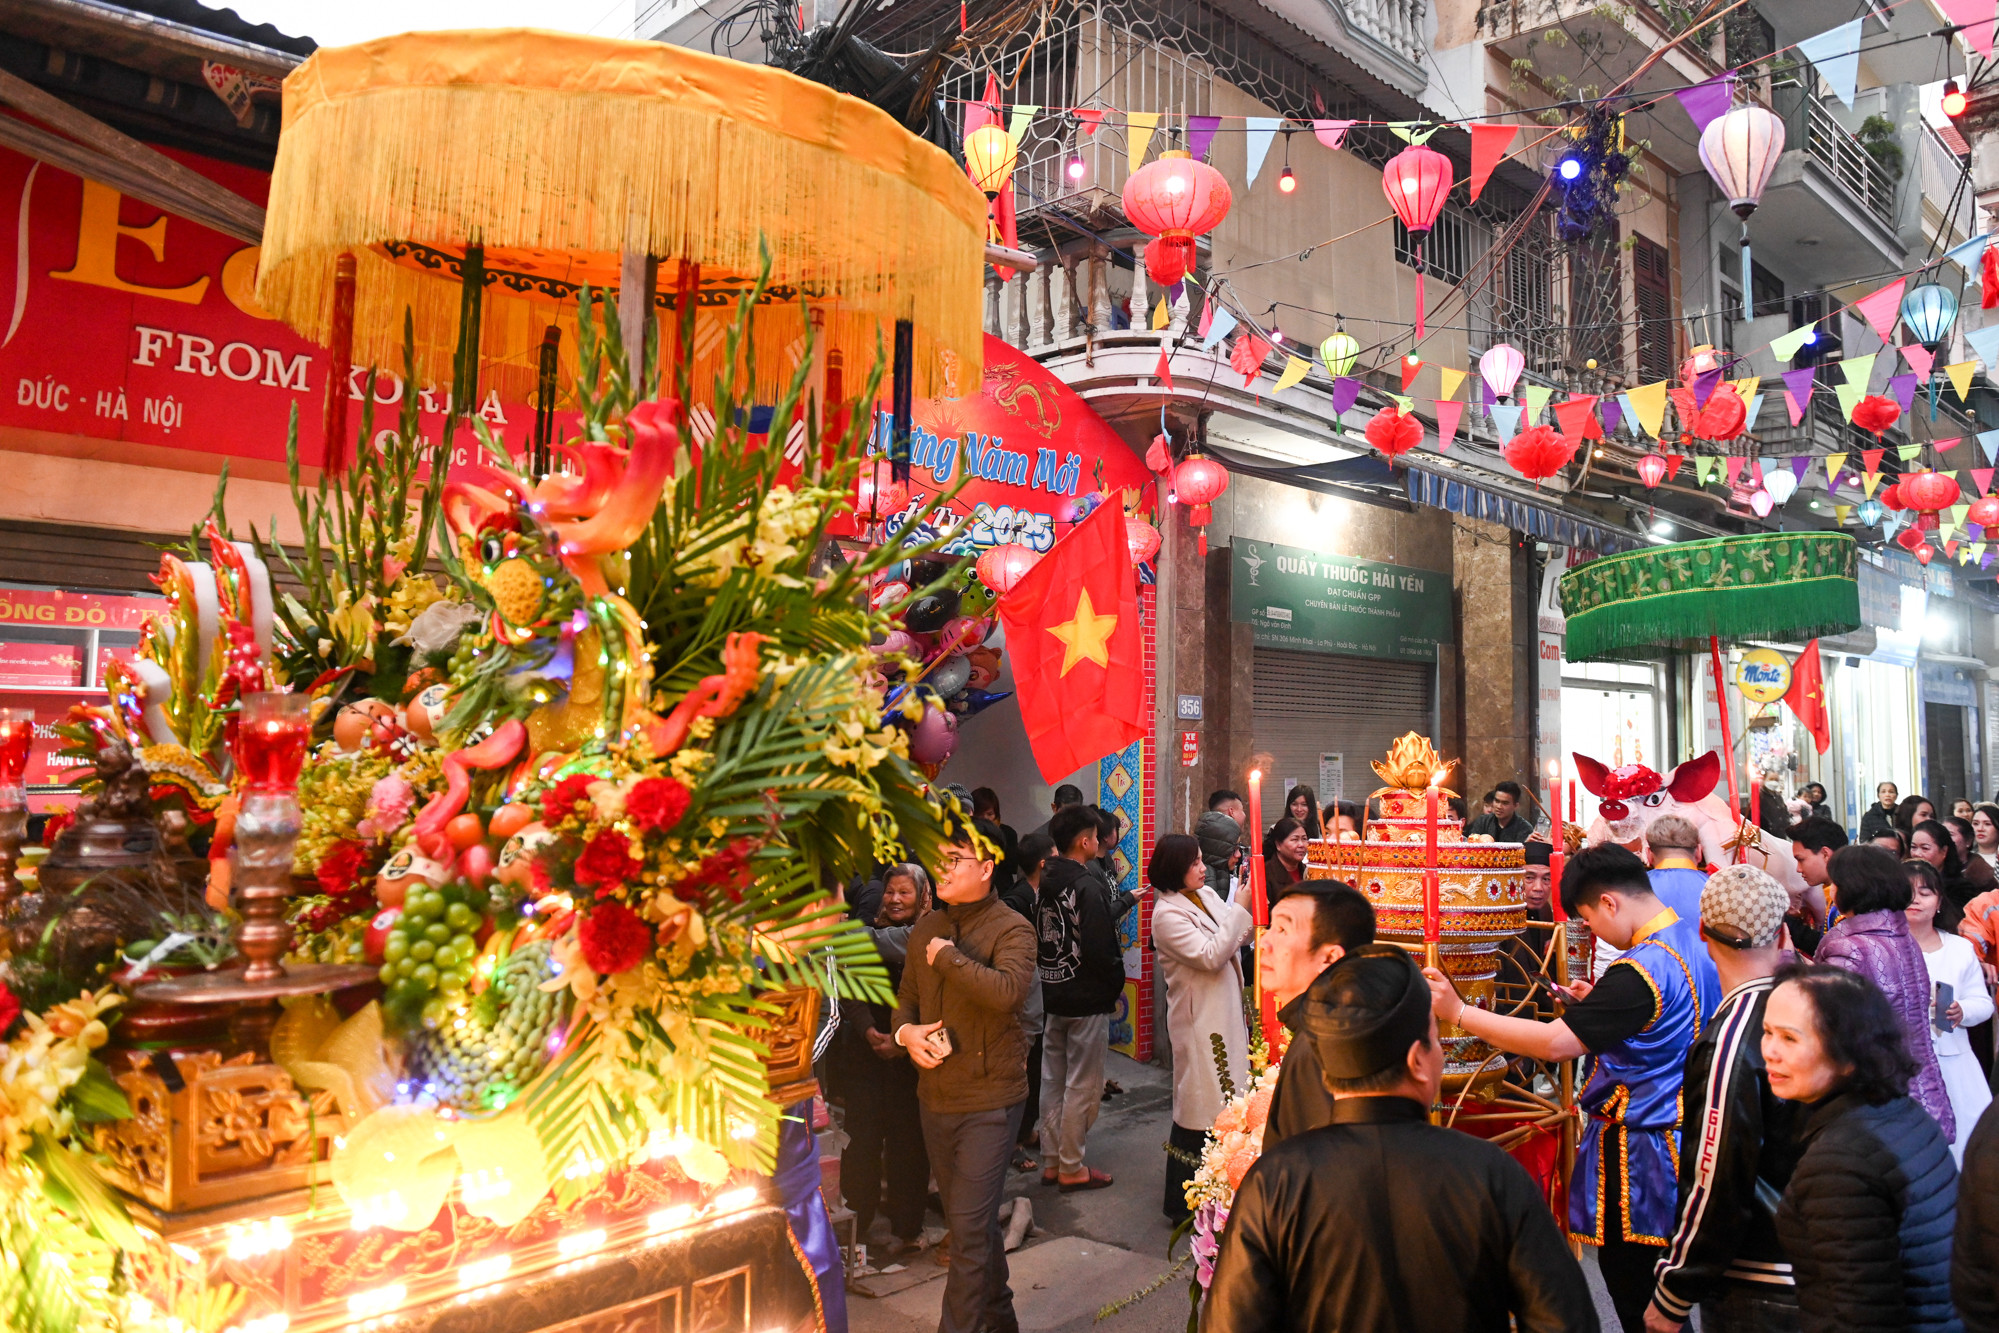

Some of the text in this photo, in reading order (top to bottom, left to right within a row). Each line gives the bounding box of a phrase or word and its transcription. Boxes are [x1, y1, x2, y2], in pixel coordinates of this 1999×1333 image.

[132, 326, 313, 392] FROM
[16, 374, 70, 412] ĐỨC
[95, 386, 129, 421] HÀ
[143, 395, 183, 434] NỘI
[964, 430, 1029, 487] Năm
[1031, 447, 1082, 496] Mới
[971, 501, 1056, 553] 2025
[1321, 562, 1369, 586] THUỐC
[1372, 567, 1396, 589] HẢI
[1398, 573, 1424, 593] YẾN
[1304, 599, 1328, 610] CHUYÊN
[1368, 593, 1382, 602] GPP
[65, 601, 106, 624] ĐỎ
[1744, 664, 1780, 683] Monte
[1181, 699, 1200, 715] 356
[1183, 741, 1197, 752] ÔM
[1185, 733, 1196, 741] XE
[1700, 1108, 1719, 1187] GUCCI
